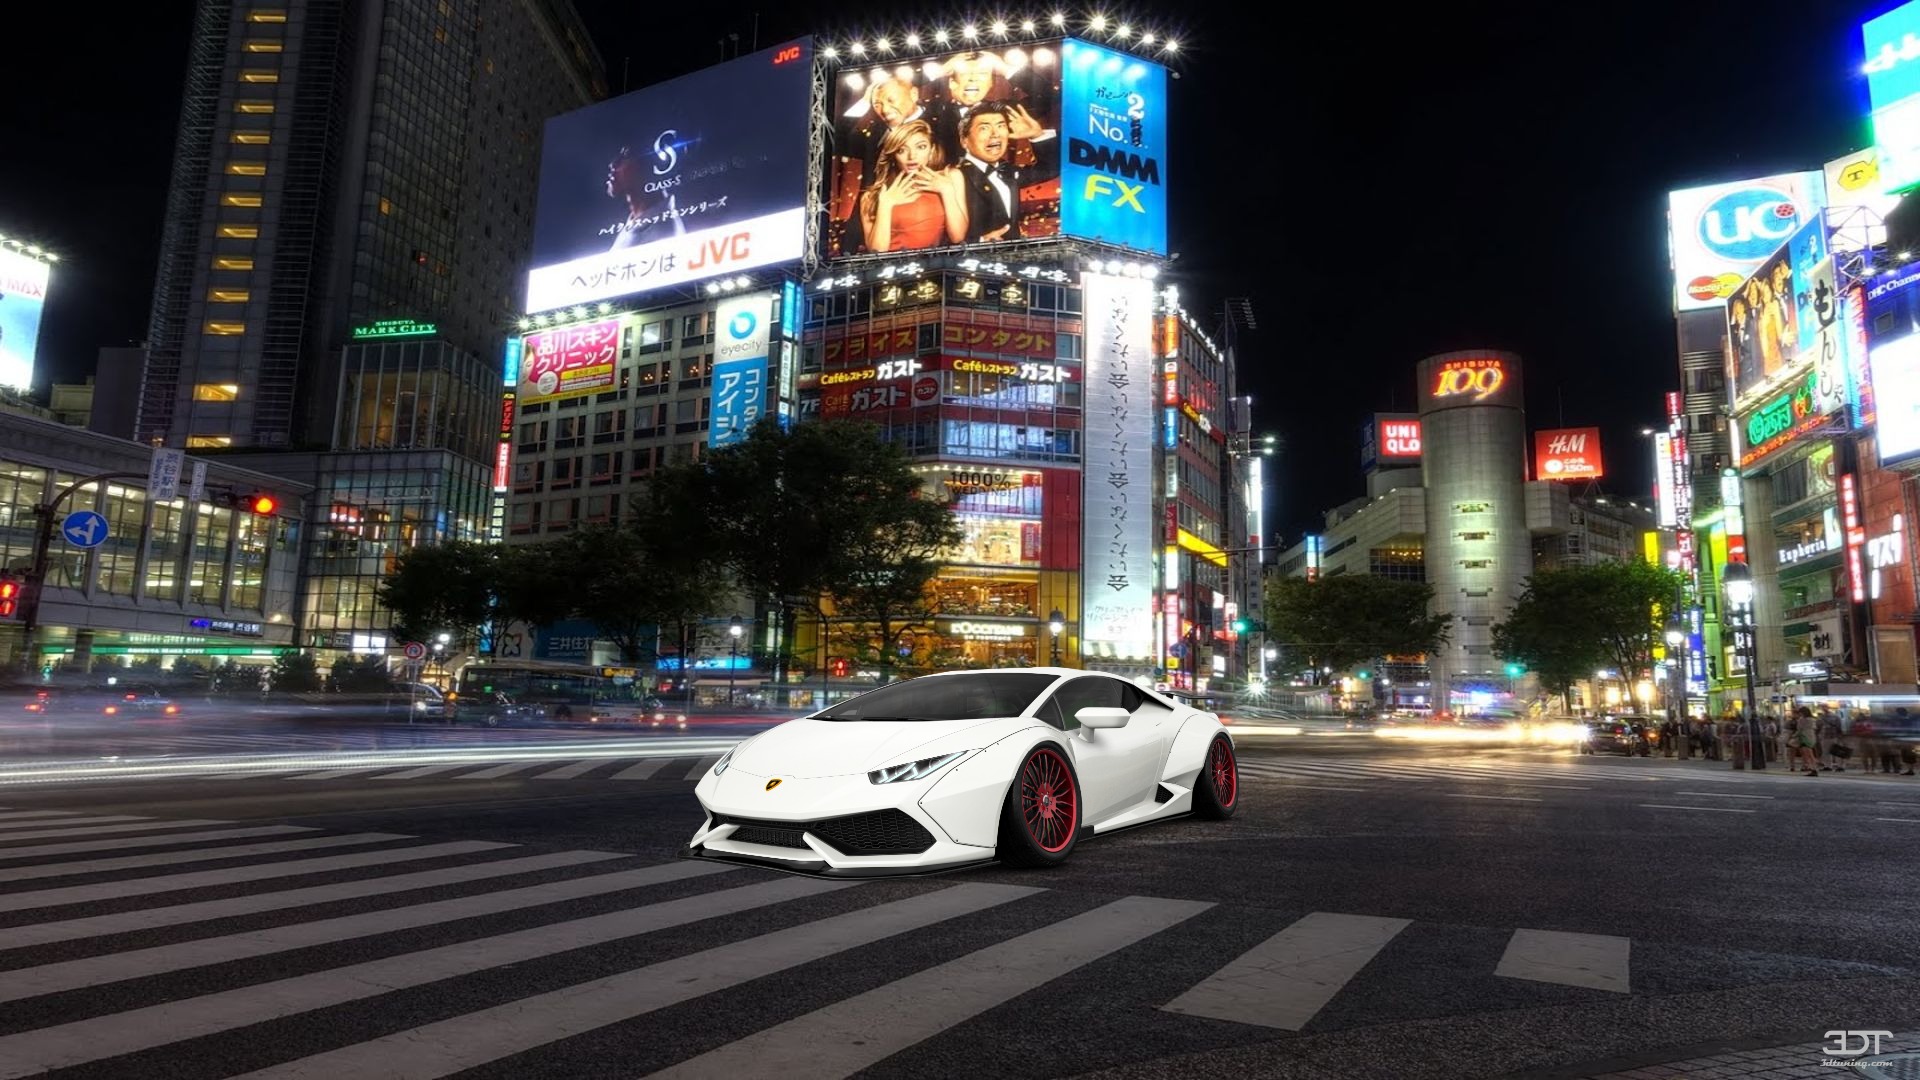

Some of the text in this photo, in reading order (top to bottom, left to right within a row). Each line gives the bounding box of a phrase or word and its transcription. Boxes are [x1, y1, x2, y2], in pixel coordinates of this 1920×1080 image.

[774, 47, 801, 63] JVC
[1089, 114, 1128, 144] No.
[1069, 137, 1160, 186] DMM
[1084, 174, 1145, 214] FX
[1705, 200, 1799, 245] UC
[687, 232, 751, 270] JVC
[571, 252, 677, 288] ヘッドホンは
[356, 324, 436, 335] MARK CITY
[536, 326, 618, 357] 品川スキン
[944, 325, 1052, 352] コンタクト
[721, 339, 763, 356] eyecity
[535, 344, 616, 376] クリニック
[877, 359, 922, 380] ガスト
[1445, 361, 1500, 369] SHIBUYA
[1020, 362, 1072, 383] ガスト
[1433, 367, 1504, 400] 109
[801, 399, 820, 414] 7F
[851, 386, 907, 411] ガスト
[1386, 425, 1417, 438] UNI
[1386, 439, 1421, 454] QLO
[1548, 433, 1586, 455] H&M
[951, 471, 1011, 490] 1000%
[1779, 539, 1826, 563] Euphoria
